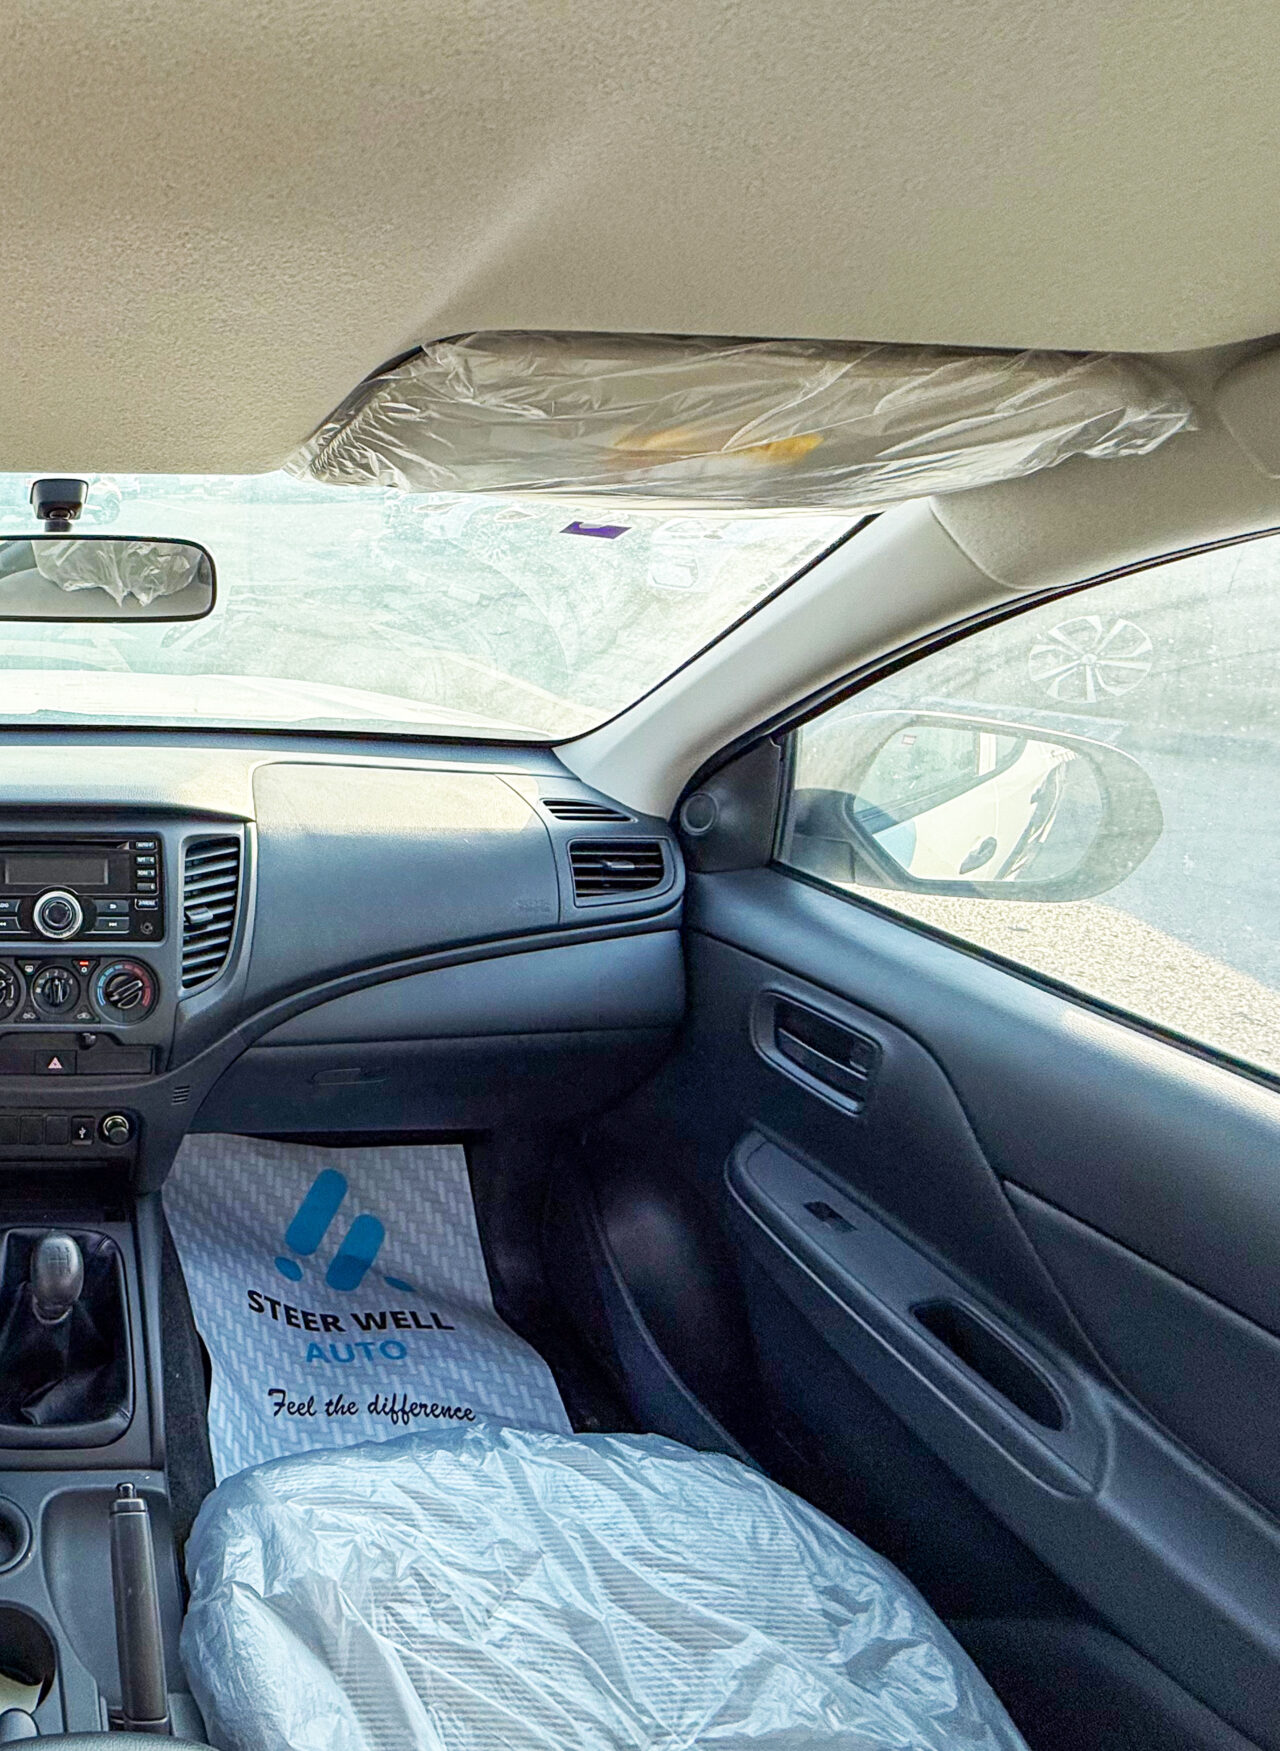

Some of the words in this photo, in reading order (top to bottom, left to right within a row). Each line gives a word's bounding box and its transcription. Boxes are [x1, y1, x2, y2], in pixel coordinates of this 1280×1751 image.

[247, 1290, 346, 1332] STEER
[351, 1311, 455, 1331] WELL
[306, 1339, 407, 1364] AUTO
[268, 1388, 317, 1417] Feel
[324, 1393, 359, 1416] the
[367, 1392, 476, 1425] difference
